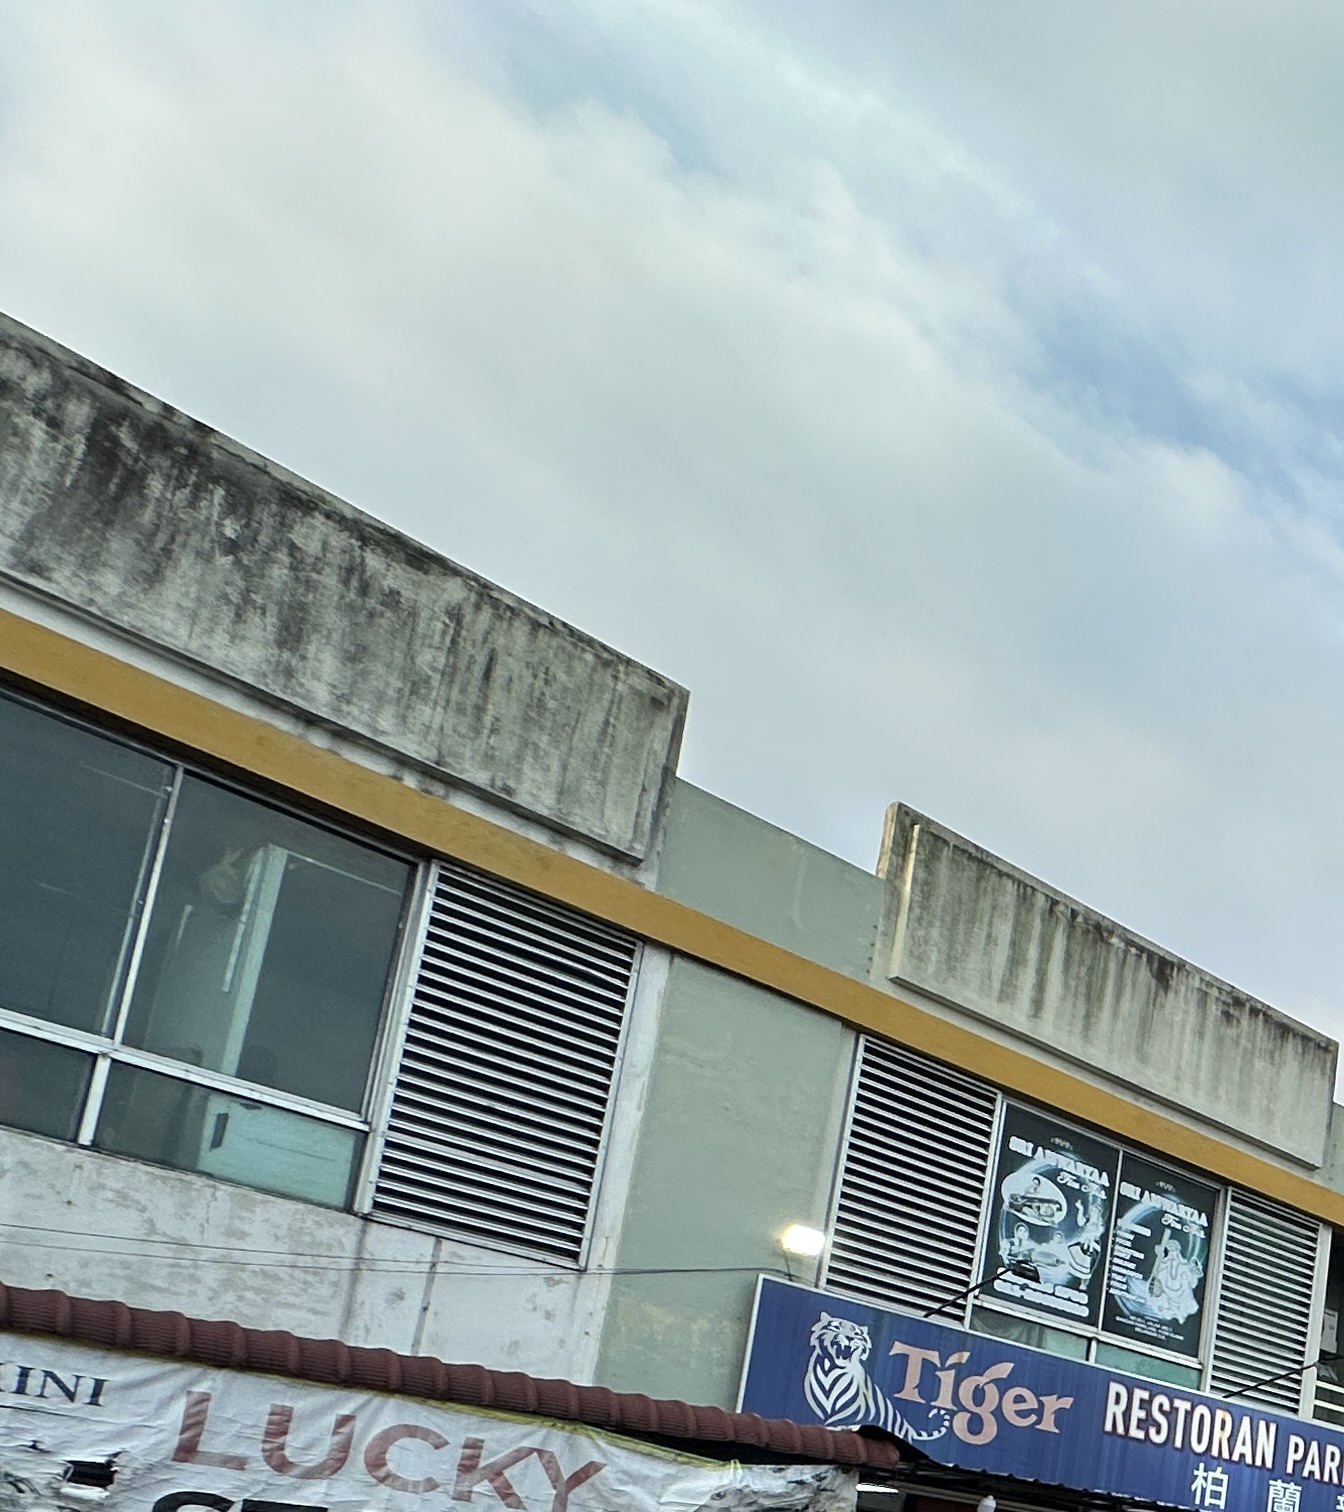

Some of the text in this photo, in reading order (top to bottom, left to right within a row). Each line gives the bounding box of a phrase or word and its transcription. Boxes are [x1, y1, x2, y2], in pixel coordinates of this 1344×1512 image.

[0, 1361, 111, 1408] INI
[889, 1341, 1074, 1445] Tiger
[1104, 1380, 1277, 1470] RESTORAN
